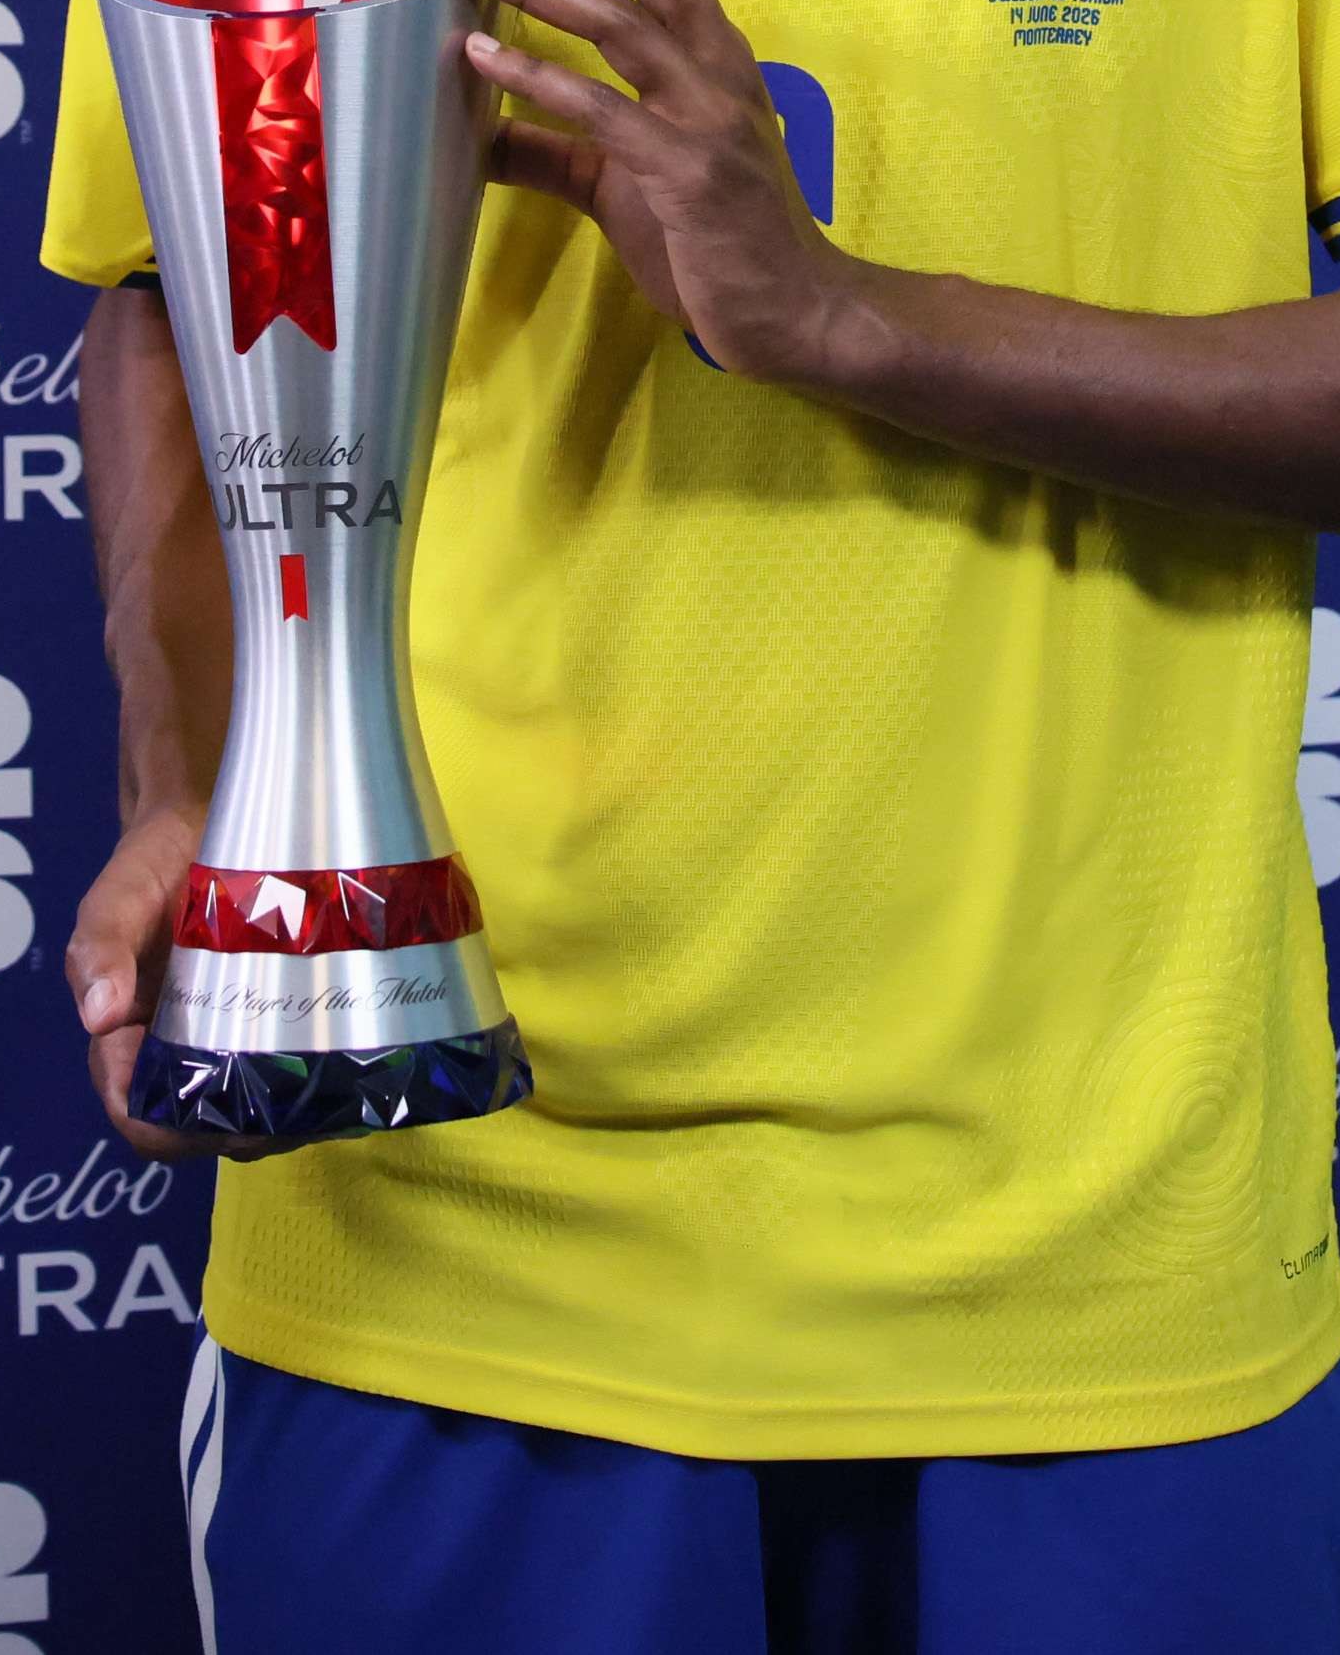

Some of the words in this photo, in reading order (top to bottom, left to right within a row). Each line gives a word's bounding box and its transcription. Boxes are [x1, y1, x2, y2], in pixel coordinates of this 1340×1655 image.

[1011, 7, 1023, 24] 14
[1027, 5, 1057, 24] JUNE
[1062, 6, 1100, 25] 2026
[1014, 27, 1092, 46] MONTERREY
[216, 433, 365, 472] Michelob
[211, 480, 402, 530] ULTRA
